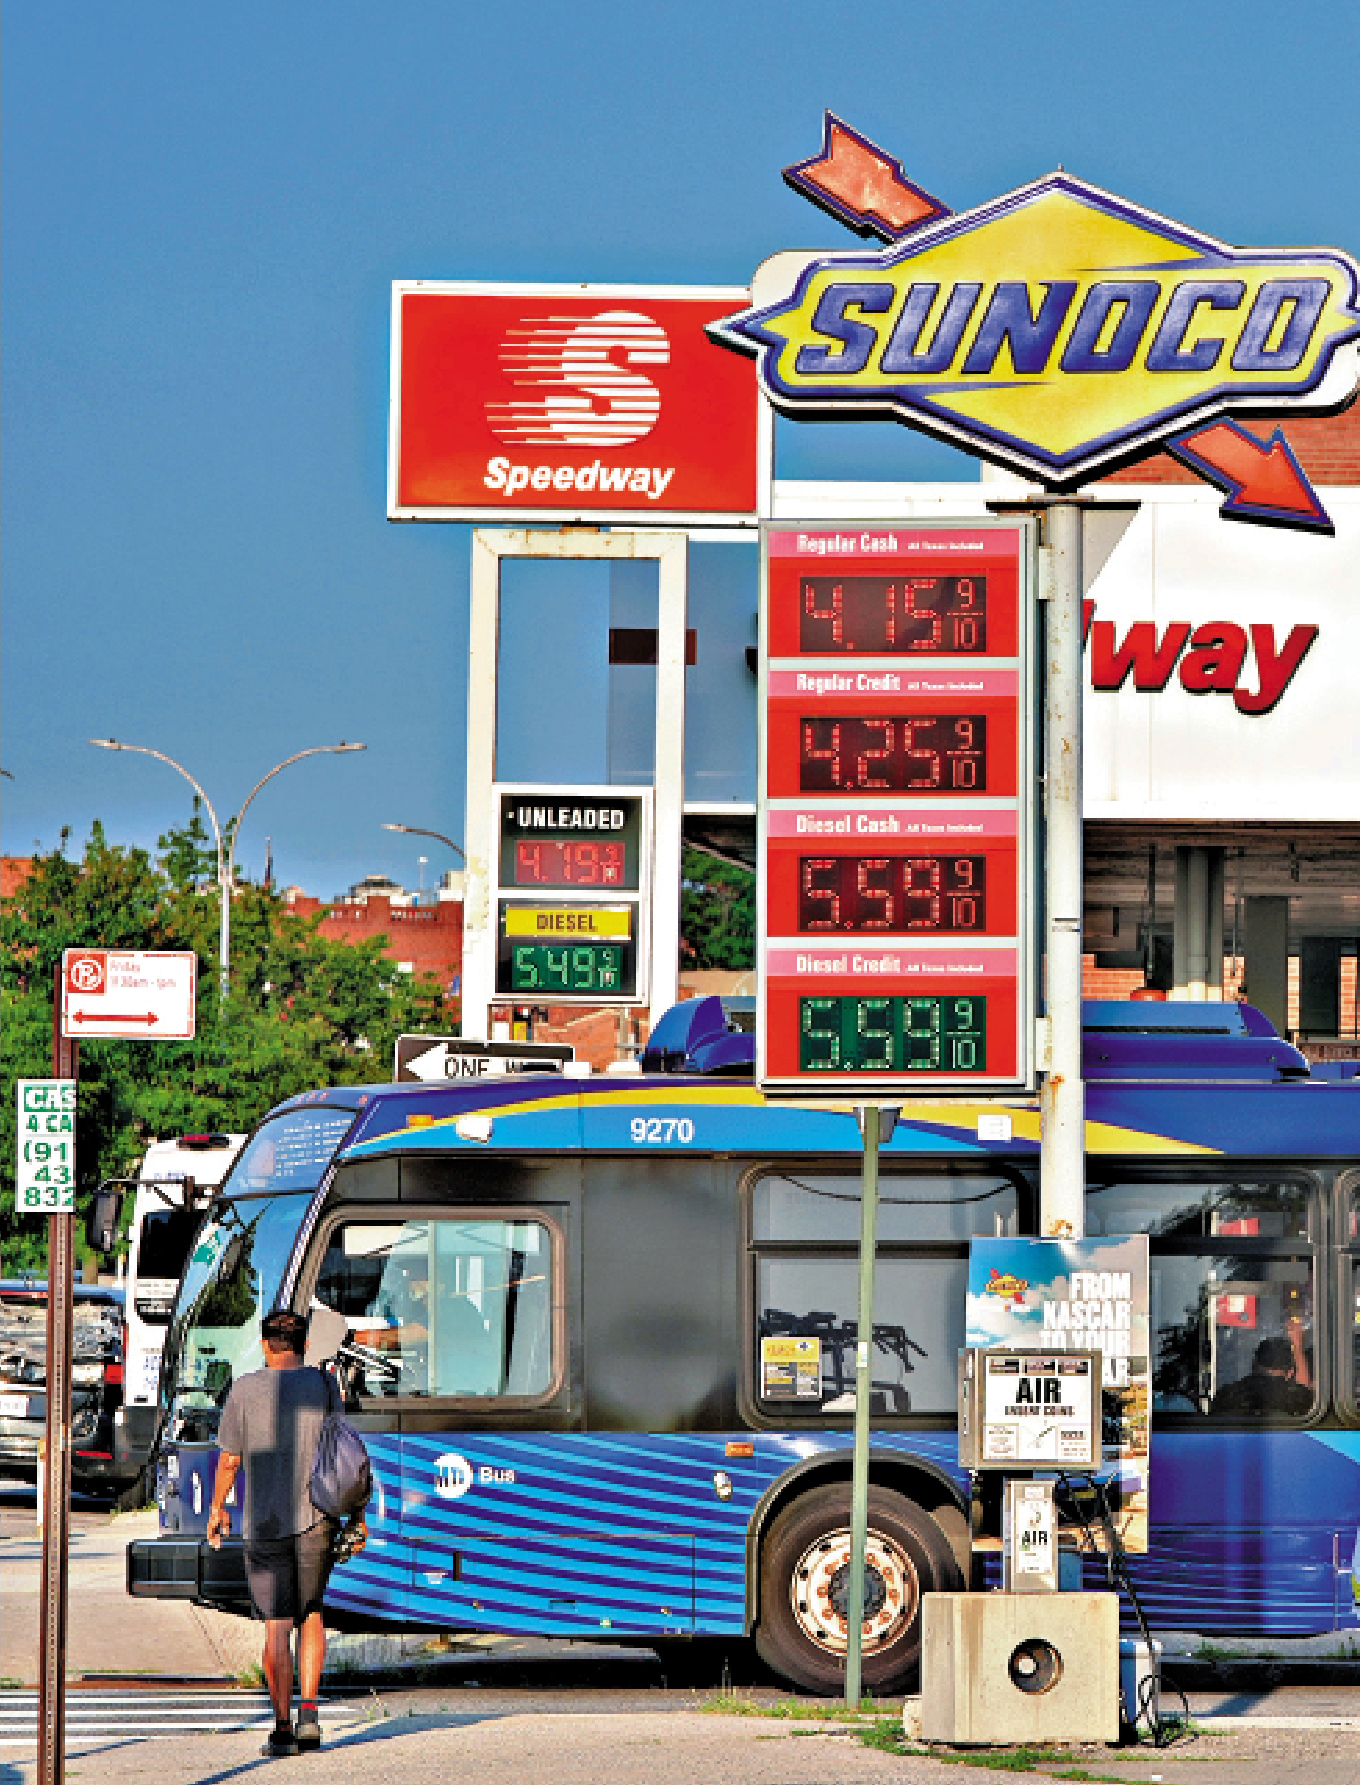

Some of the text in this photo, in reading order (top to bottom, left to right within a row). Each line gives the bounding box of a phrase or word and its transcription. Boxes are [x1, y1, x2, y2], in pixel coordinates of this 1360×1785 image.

[795, 280, 1333, 375] SUNOCO
[483, 456, 676, 499] Speedway
[797, 533, 898, 554] Regular Cash
[797, 674, 900, 696] Regular Credit
[516, 806, 626, 830] UNLEADED
[797, 814, 900, 833] Diesel Cash
[536, 914, 599, 932] DIESEL
[797, 954, 900, 973] Diesel Credit
[629, 1118, 695, 1144] 9270
[1069, 1271, 1131, 1299] FROM
[1043, 1301, 1131, 1330] NASCAR
[1071, 1330, 1131, 1356] YOUR
[1016, 1377, 1061, 1404] AIR
[1021, 1530, 1047, 1545] AIR
